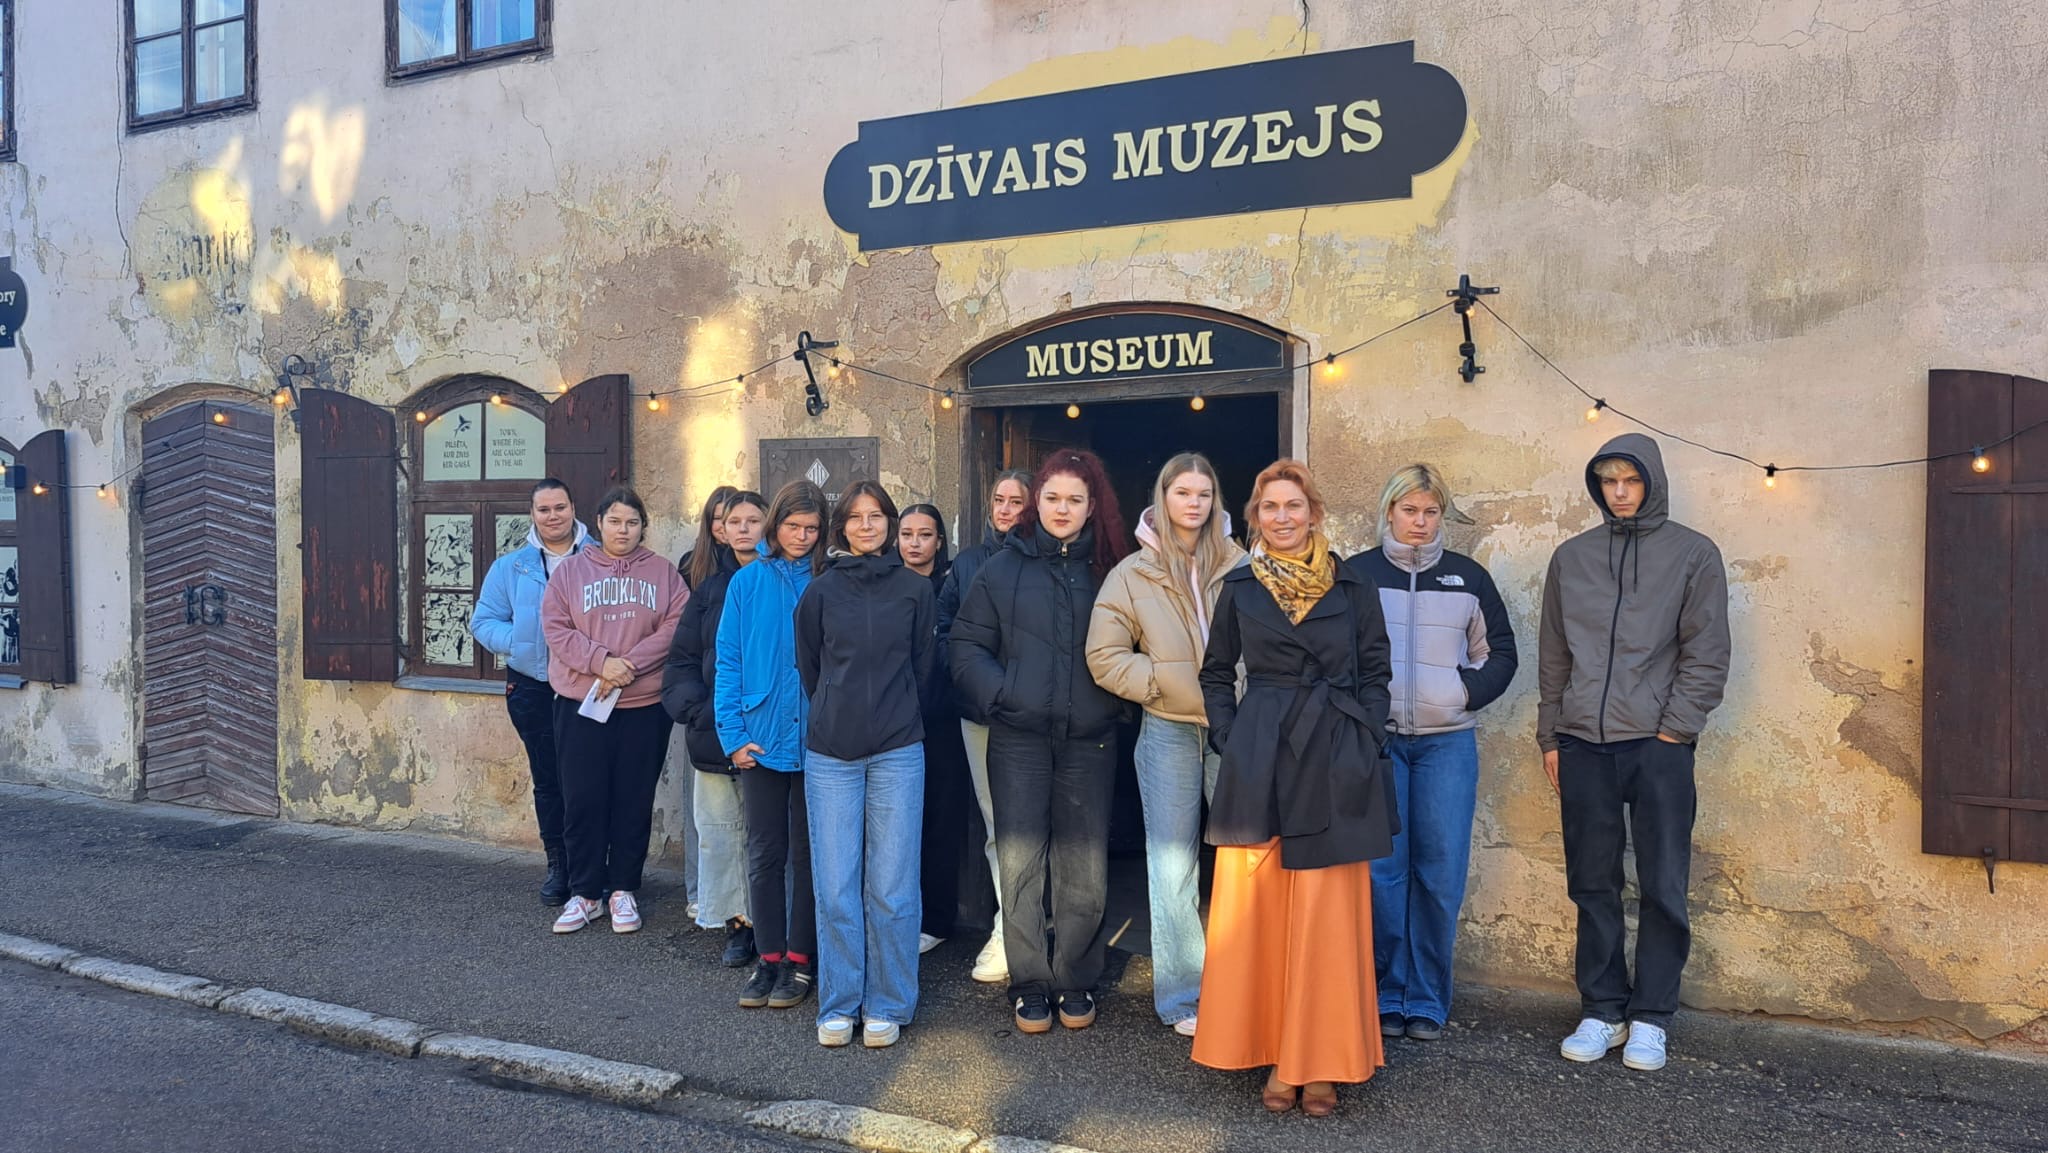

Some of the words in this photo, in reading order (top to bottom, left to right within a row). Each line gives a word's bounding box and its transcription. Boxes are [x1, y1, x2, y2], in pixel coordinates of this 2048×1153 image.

[868, 138, 1087, 209] DZĪVAIS
[1112, 99, 1383, 180] MUZEJS
[1026, 331, 1213, 377] MUSEUM
[492, 438, 511, 446] WHERE
[513, 438, 526, 446] FISH
[503, 448, 526, 456] CAUGHT
[502, 459, 512, 467] THE
[583, 576, 657, 613] BROOKLYN
[620, 610, 636, 620] YORK
